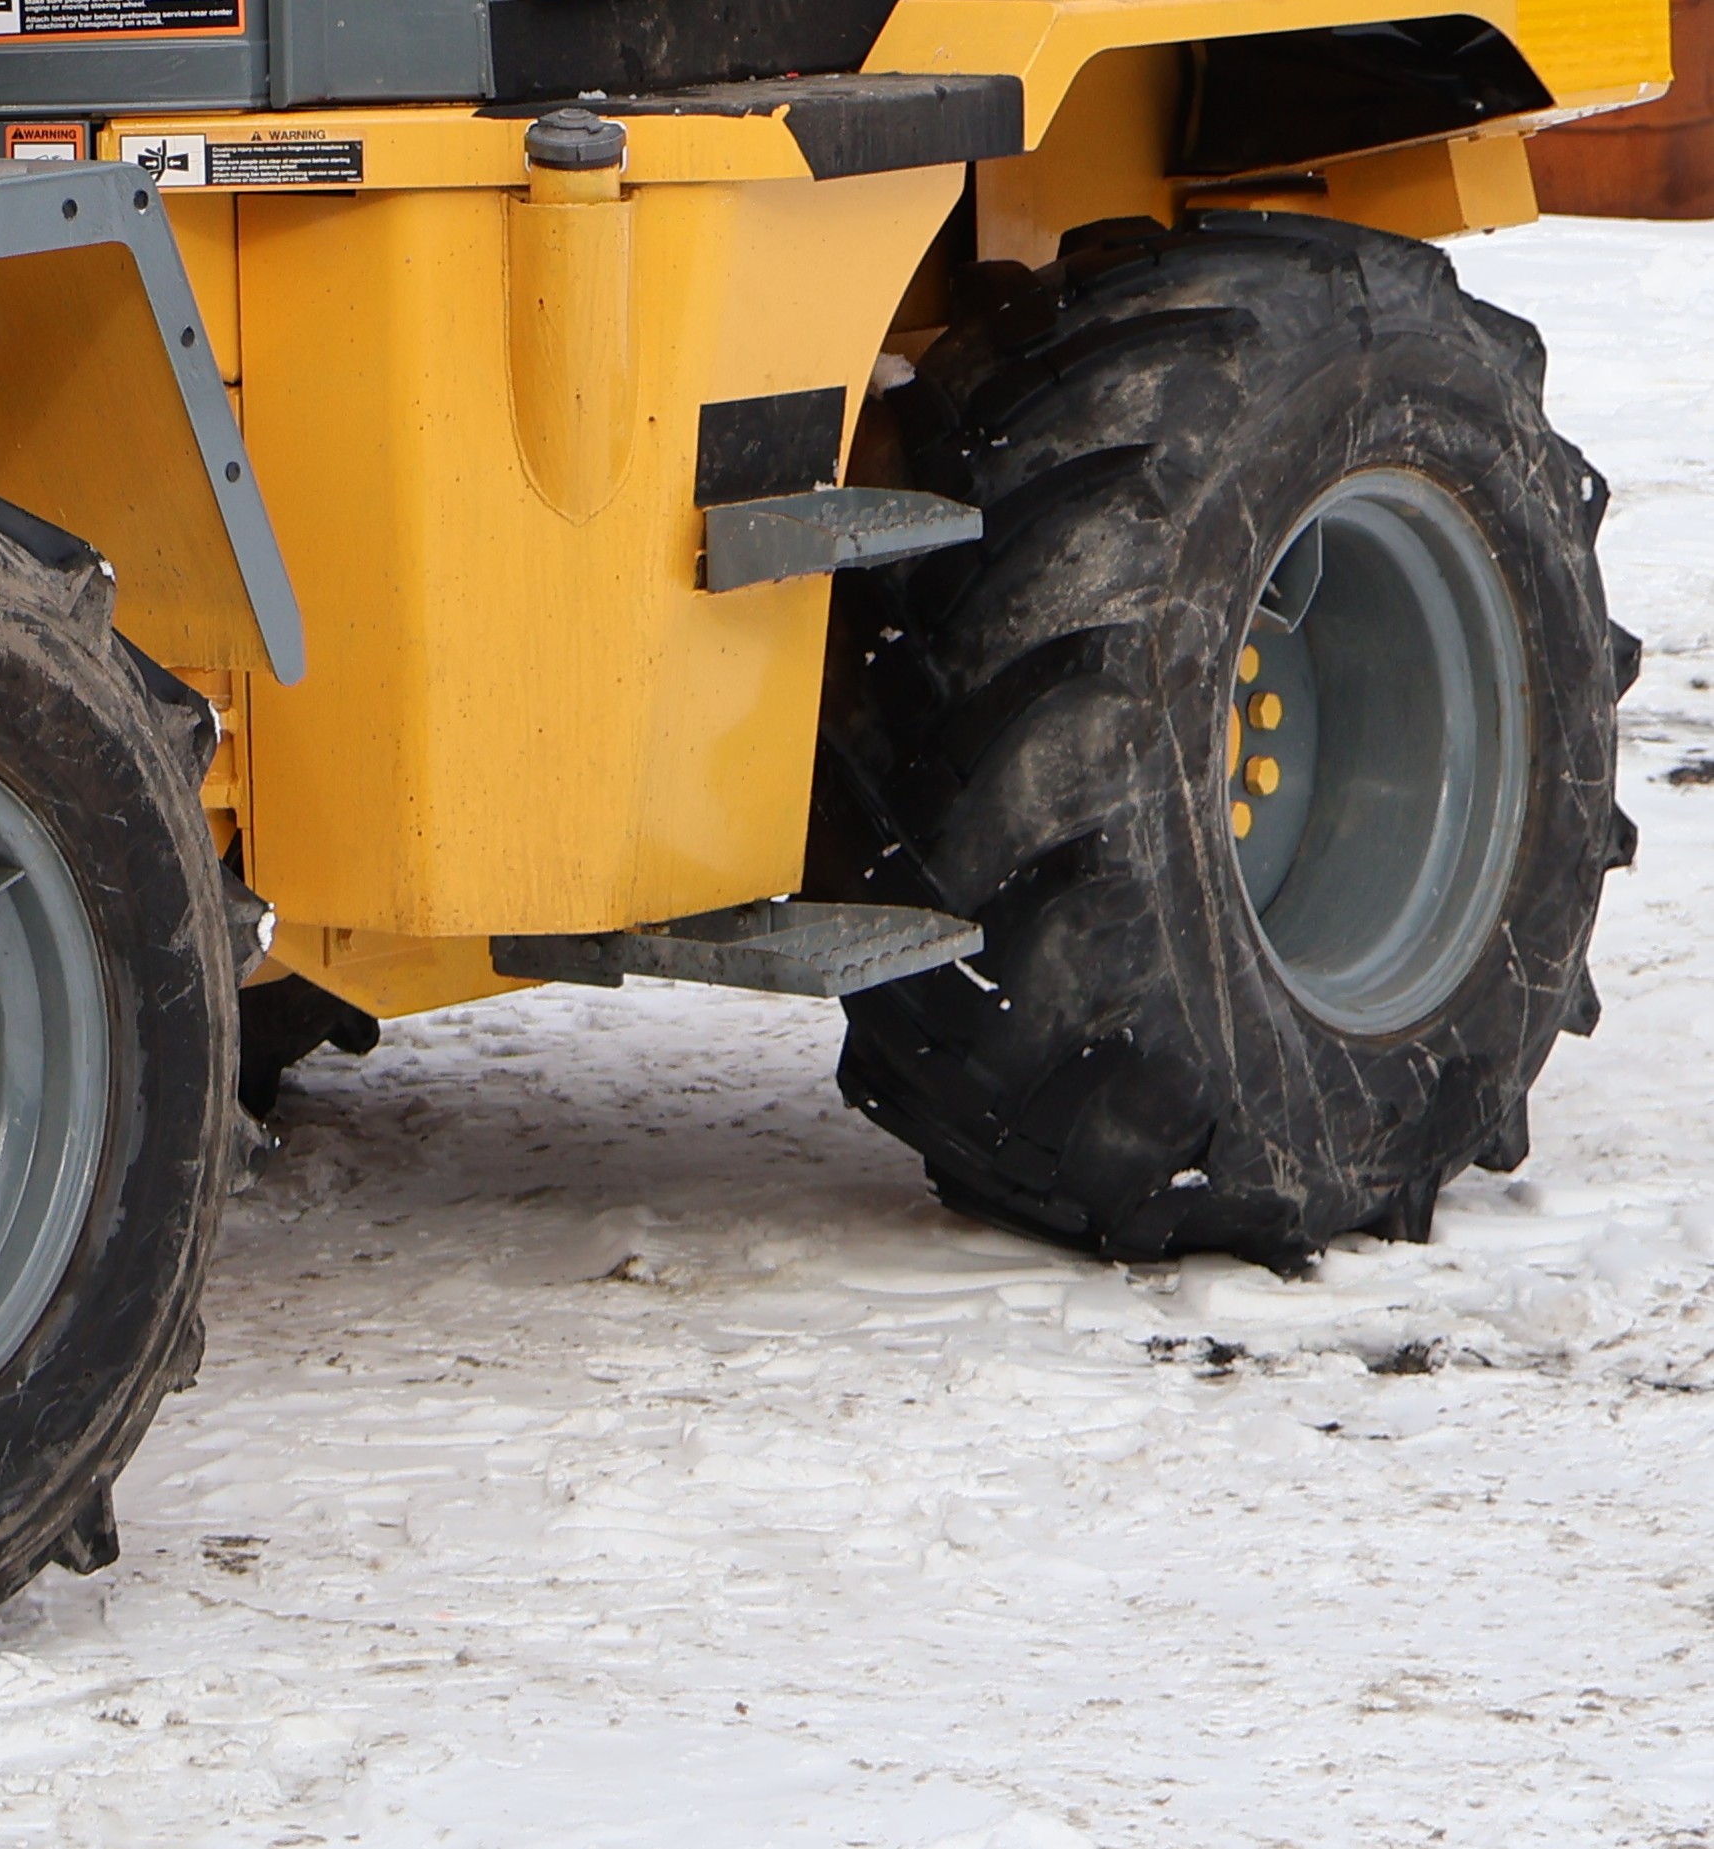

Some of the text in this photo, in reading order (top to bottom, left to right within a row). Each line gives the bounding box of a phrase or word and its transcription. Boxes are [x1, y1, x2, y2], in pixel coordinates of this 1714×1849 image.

[51, 14, 78, 23] locking
[78, 21, 123, 29] transporting
[23, 129, 77, 140] WARNING
[269, 130, 326, 140] WARNING
